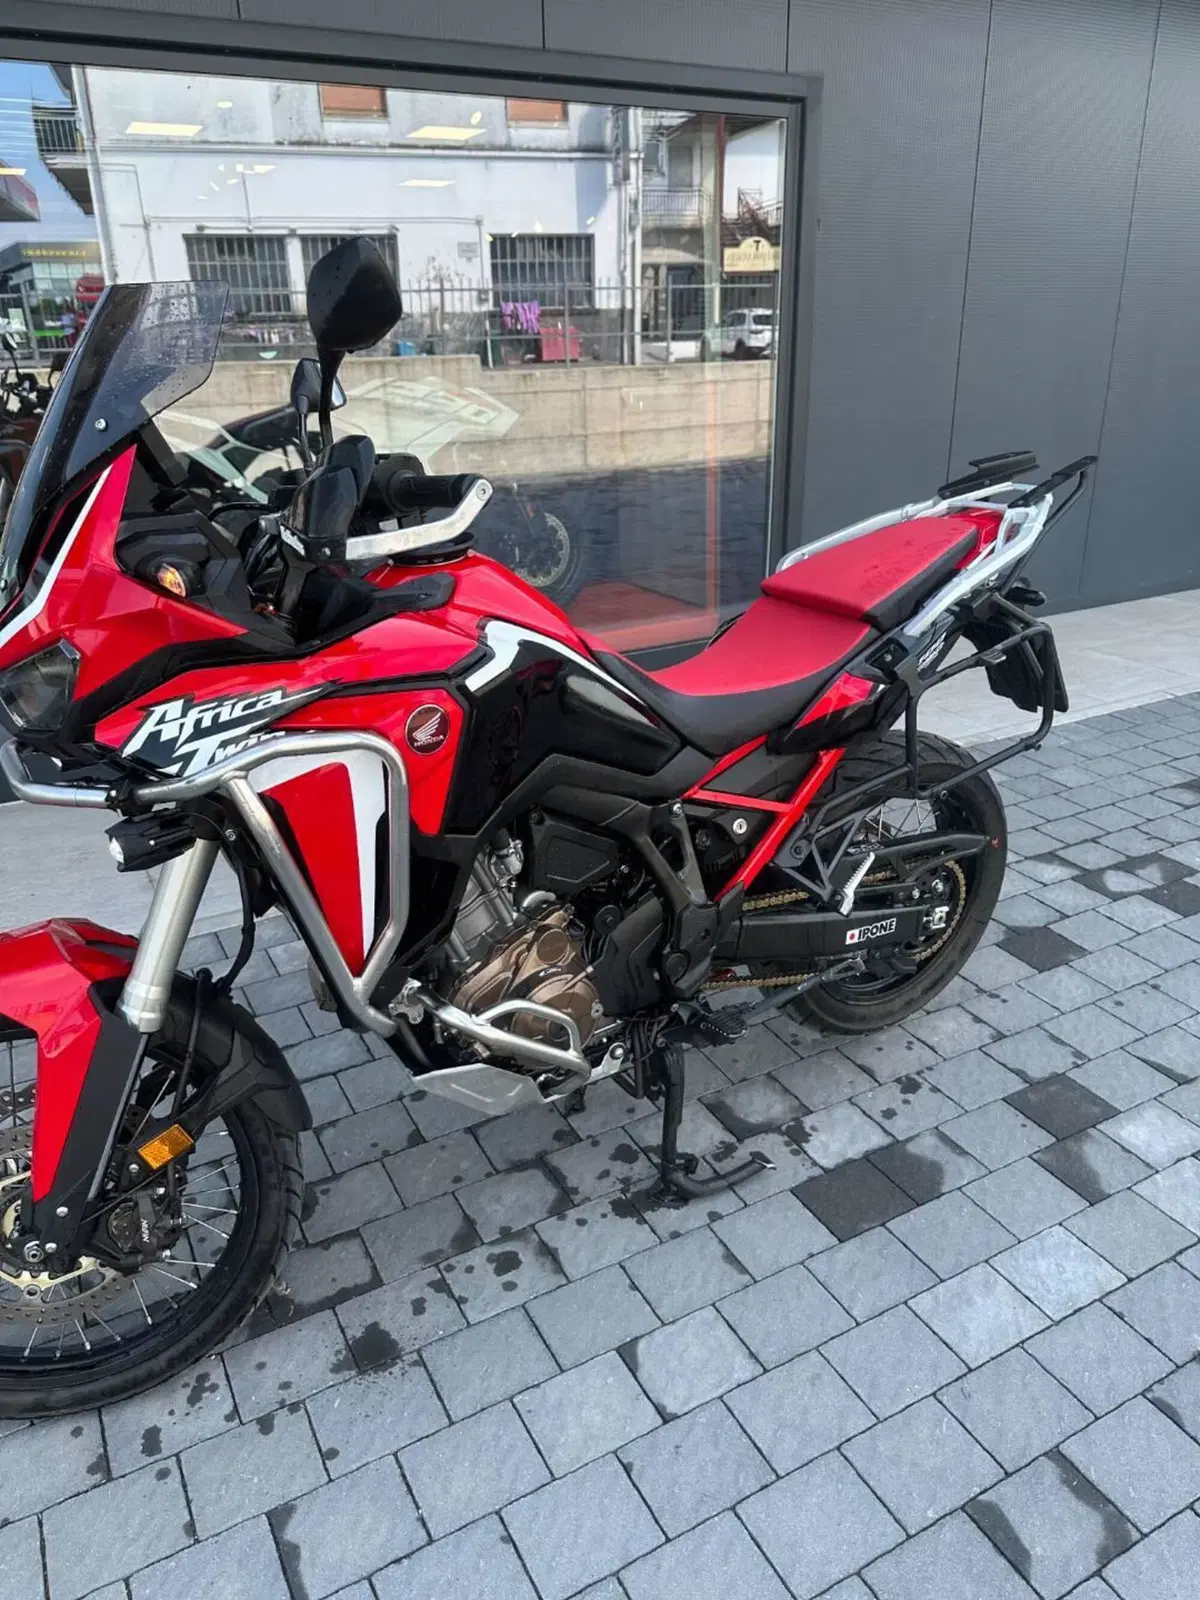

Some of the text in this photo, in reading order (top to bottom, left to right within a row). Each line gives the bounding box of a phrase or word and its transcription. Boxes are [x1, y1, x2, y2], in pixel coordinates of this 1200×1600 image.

[122, 689, 322, 758] Africa
[414, 735, 444, 747] HONDA
[858, 919, 896, 941] IPONE
